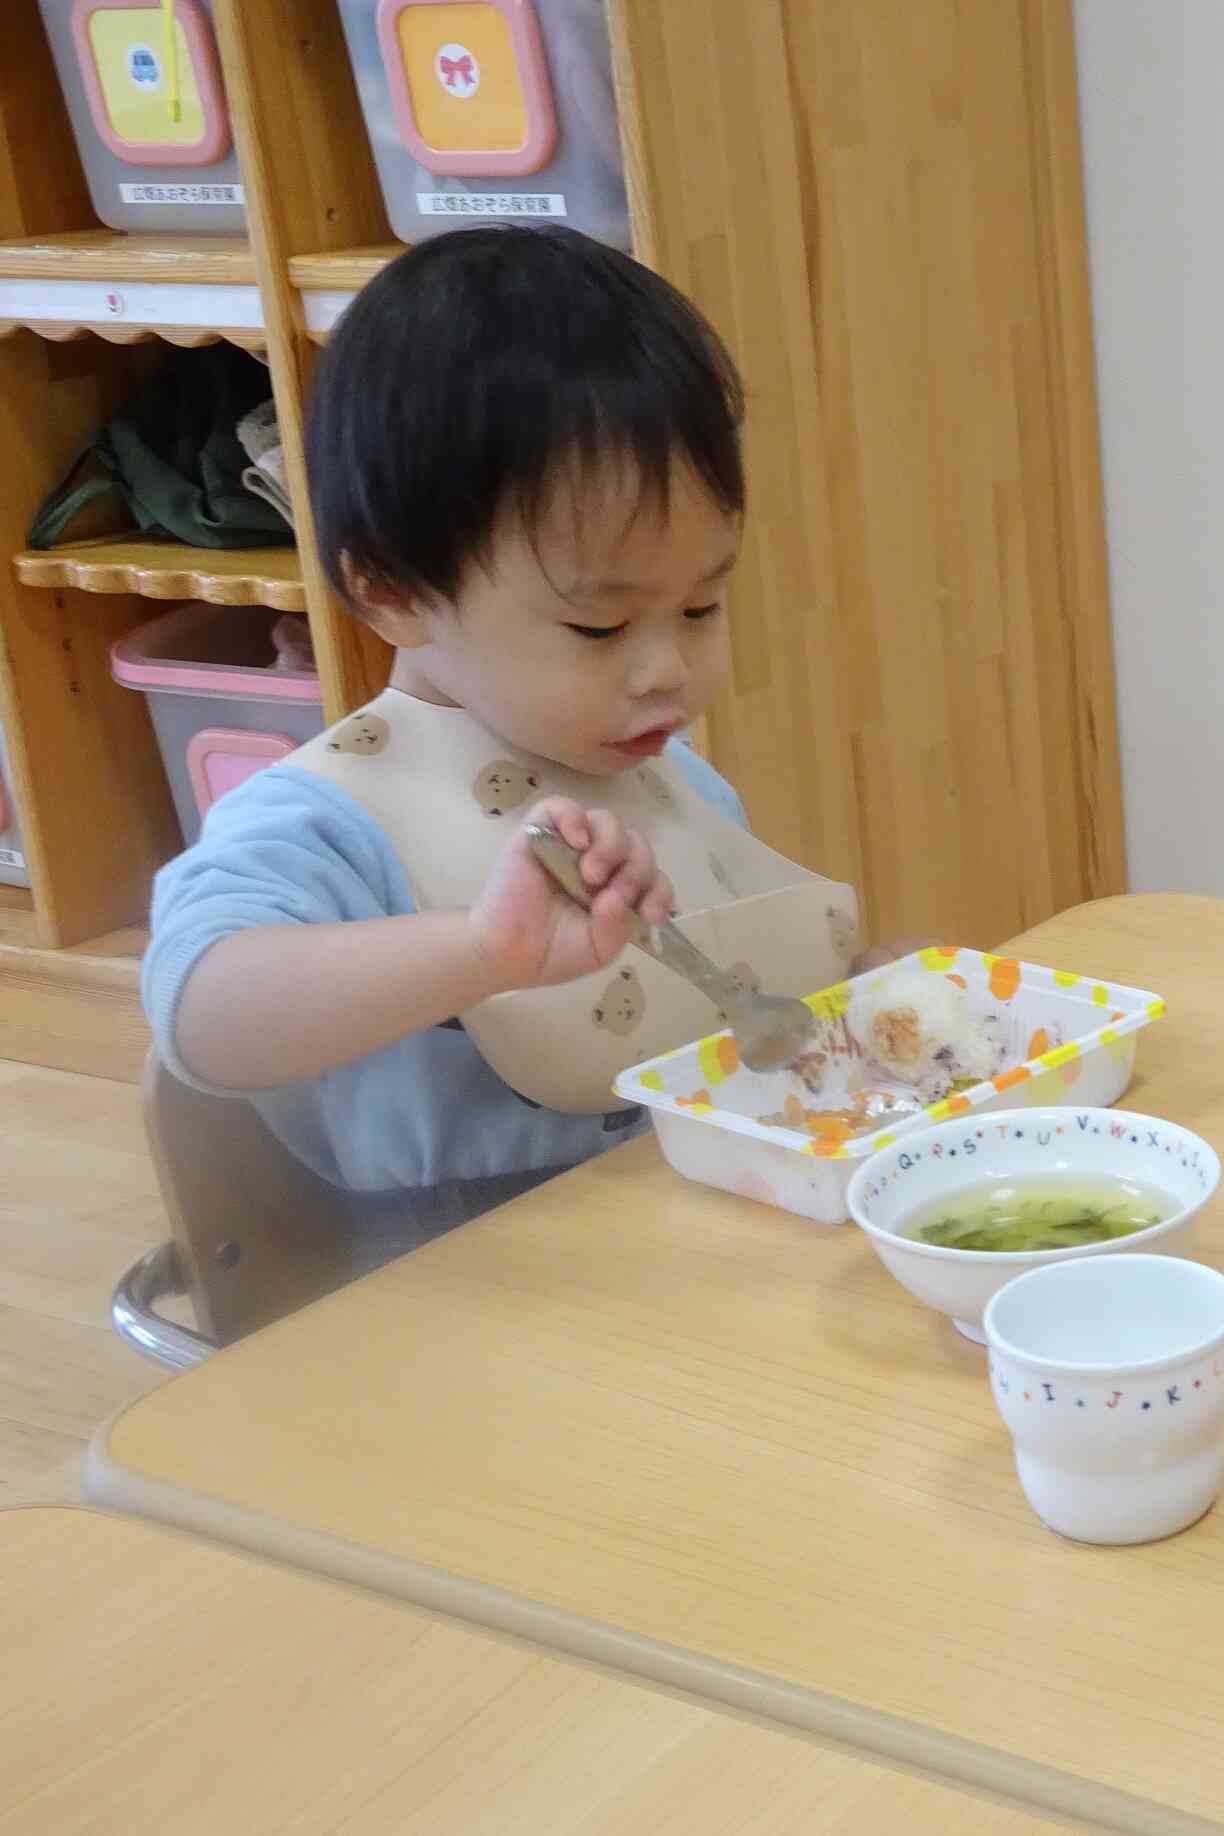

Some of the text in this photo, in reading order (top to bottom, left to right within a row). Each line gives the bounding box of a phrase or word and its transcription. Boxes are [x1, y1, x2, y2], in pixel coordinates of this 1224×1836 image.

[898, 1153, 914, 1170] Q
[963, 1139, 977, 1155] S
[1076, 1115, 1088, 1130] V
[1041, 1383, 1056, 1401] I
[1107, 1390, 1124, 1408] J
[1166, 1385, 1182, 1405] K
